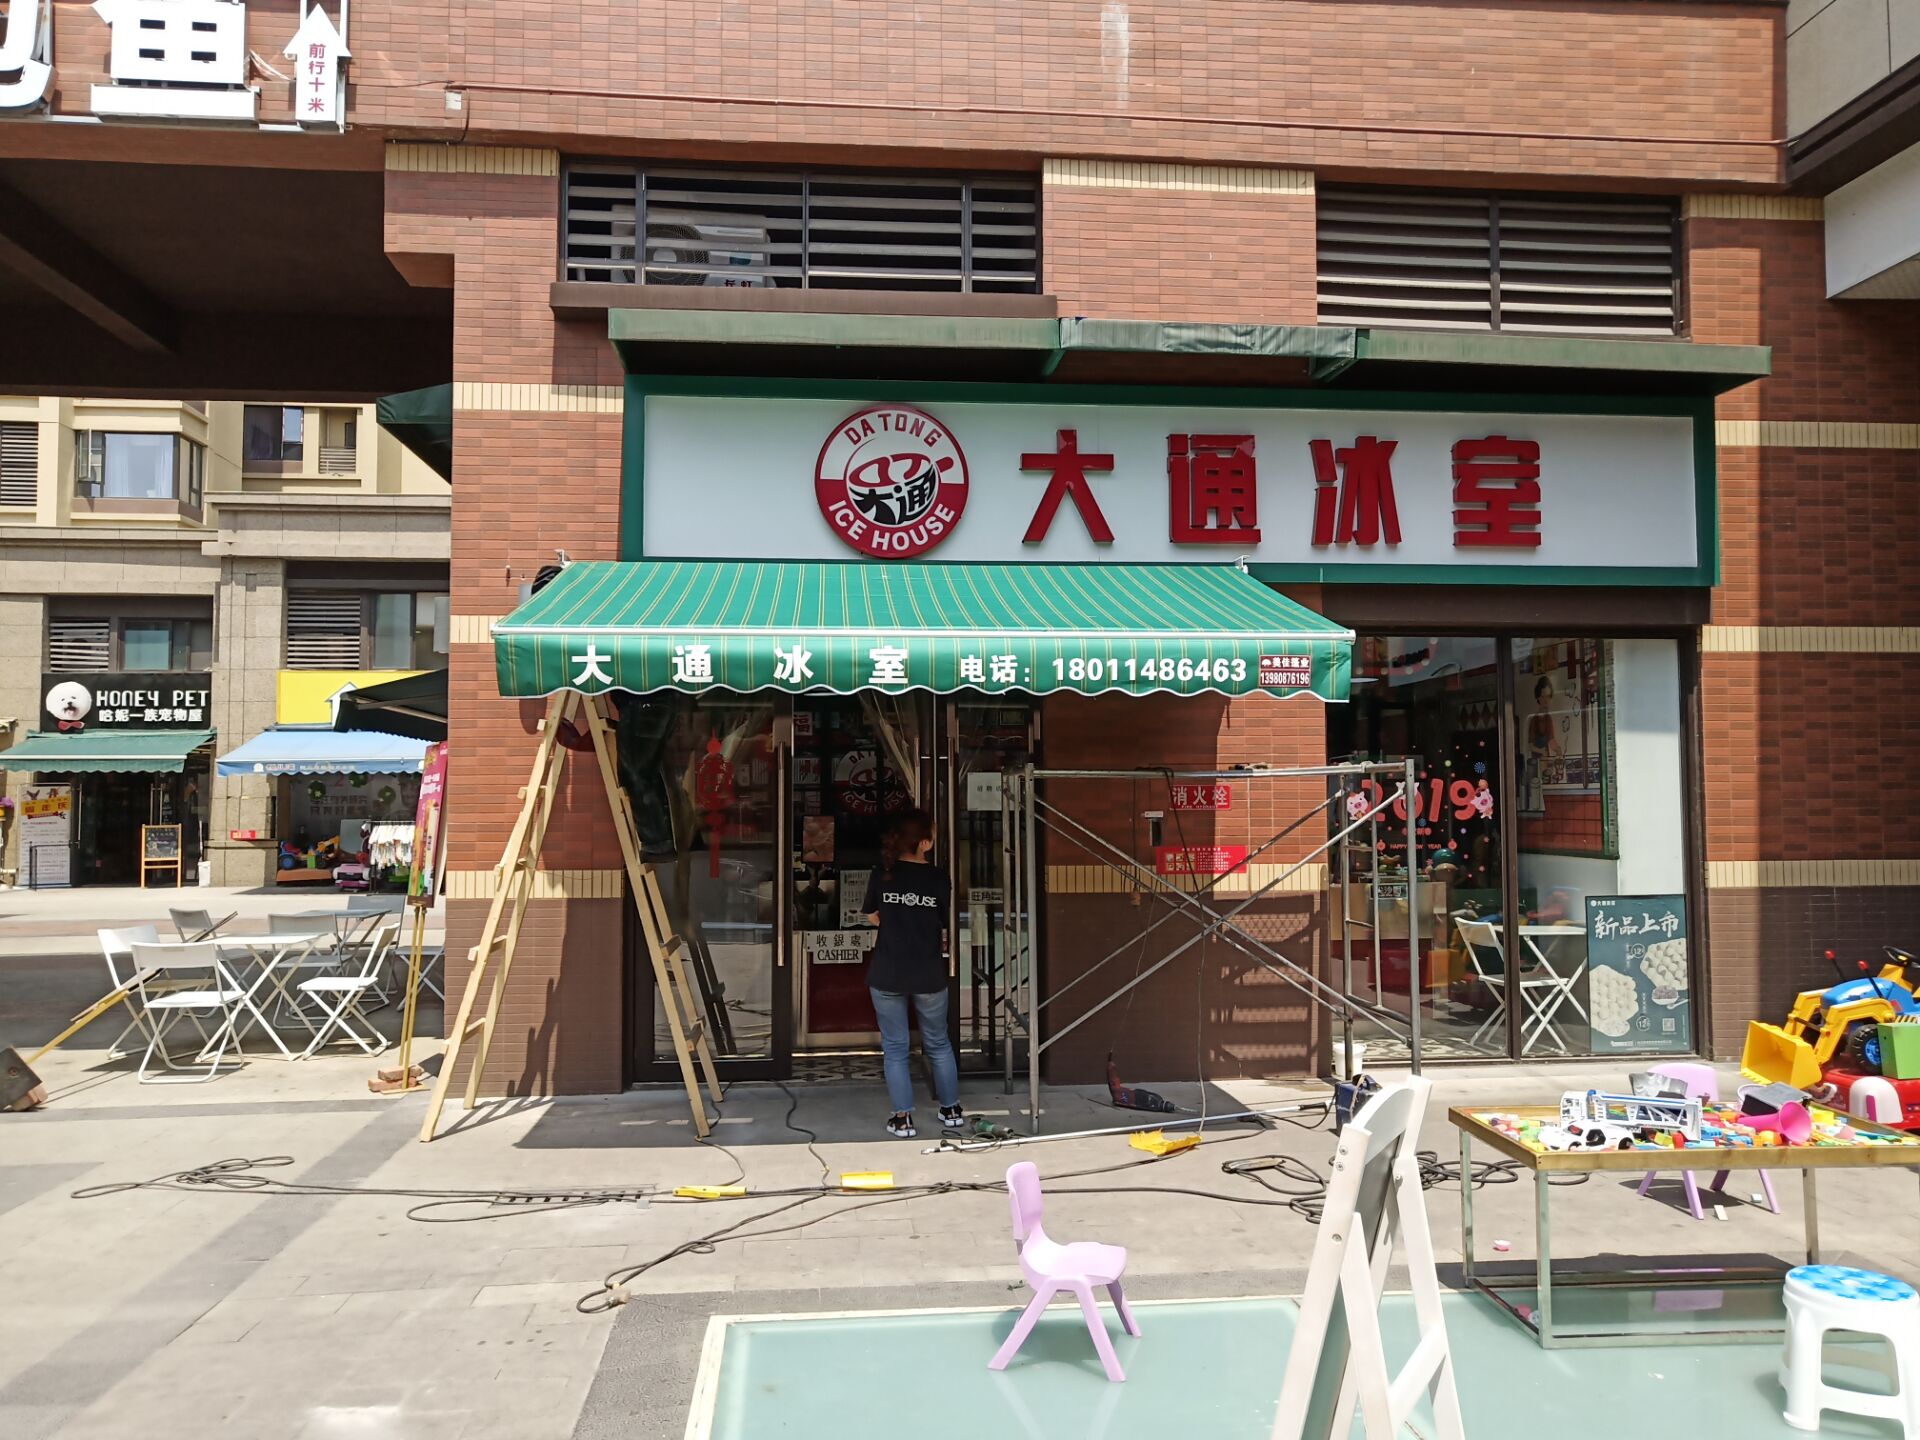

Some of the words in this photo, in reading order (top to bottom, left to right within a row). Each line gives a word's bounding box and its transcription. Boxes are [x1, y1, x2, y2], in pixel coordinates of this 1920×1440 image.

[308, 43, 326, 113] 前行十米
[843, 413, 943, 448] DATONG
[1019, 429, 1542, 547] 大通冰室
[828, 500, 867, 541] ICE
[871, 503, 956, 551] HOUSE
[571, 644, 909, 686] 大通冰室
[1052, 657, 1247, 681] 18011486463
[1261, 672, 1310, 684] 13980876196
[96, 690, 159, 707] HONEY
[173, 690, 209, 707] PET
[99, 709, 202, 722] 哈妮一族宠物屋
[1172, 786, 1228, 806] 消火栓
[1361, 778, 1478, 823] 2019
[1595, 910, 1679, 941] 新品上市
[817, 949, 860, 961] CASHIER
